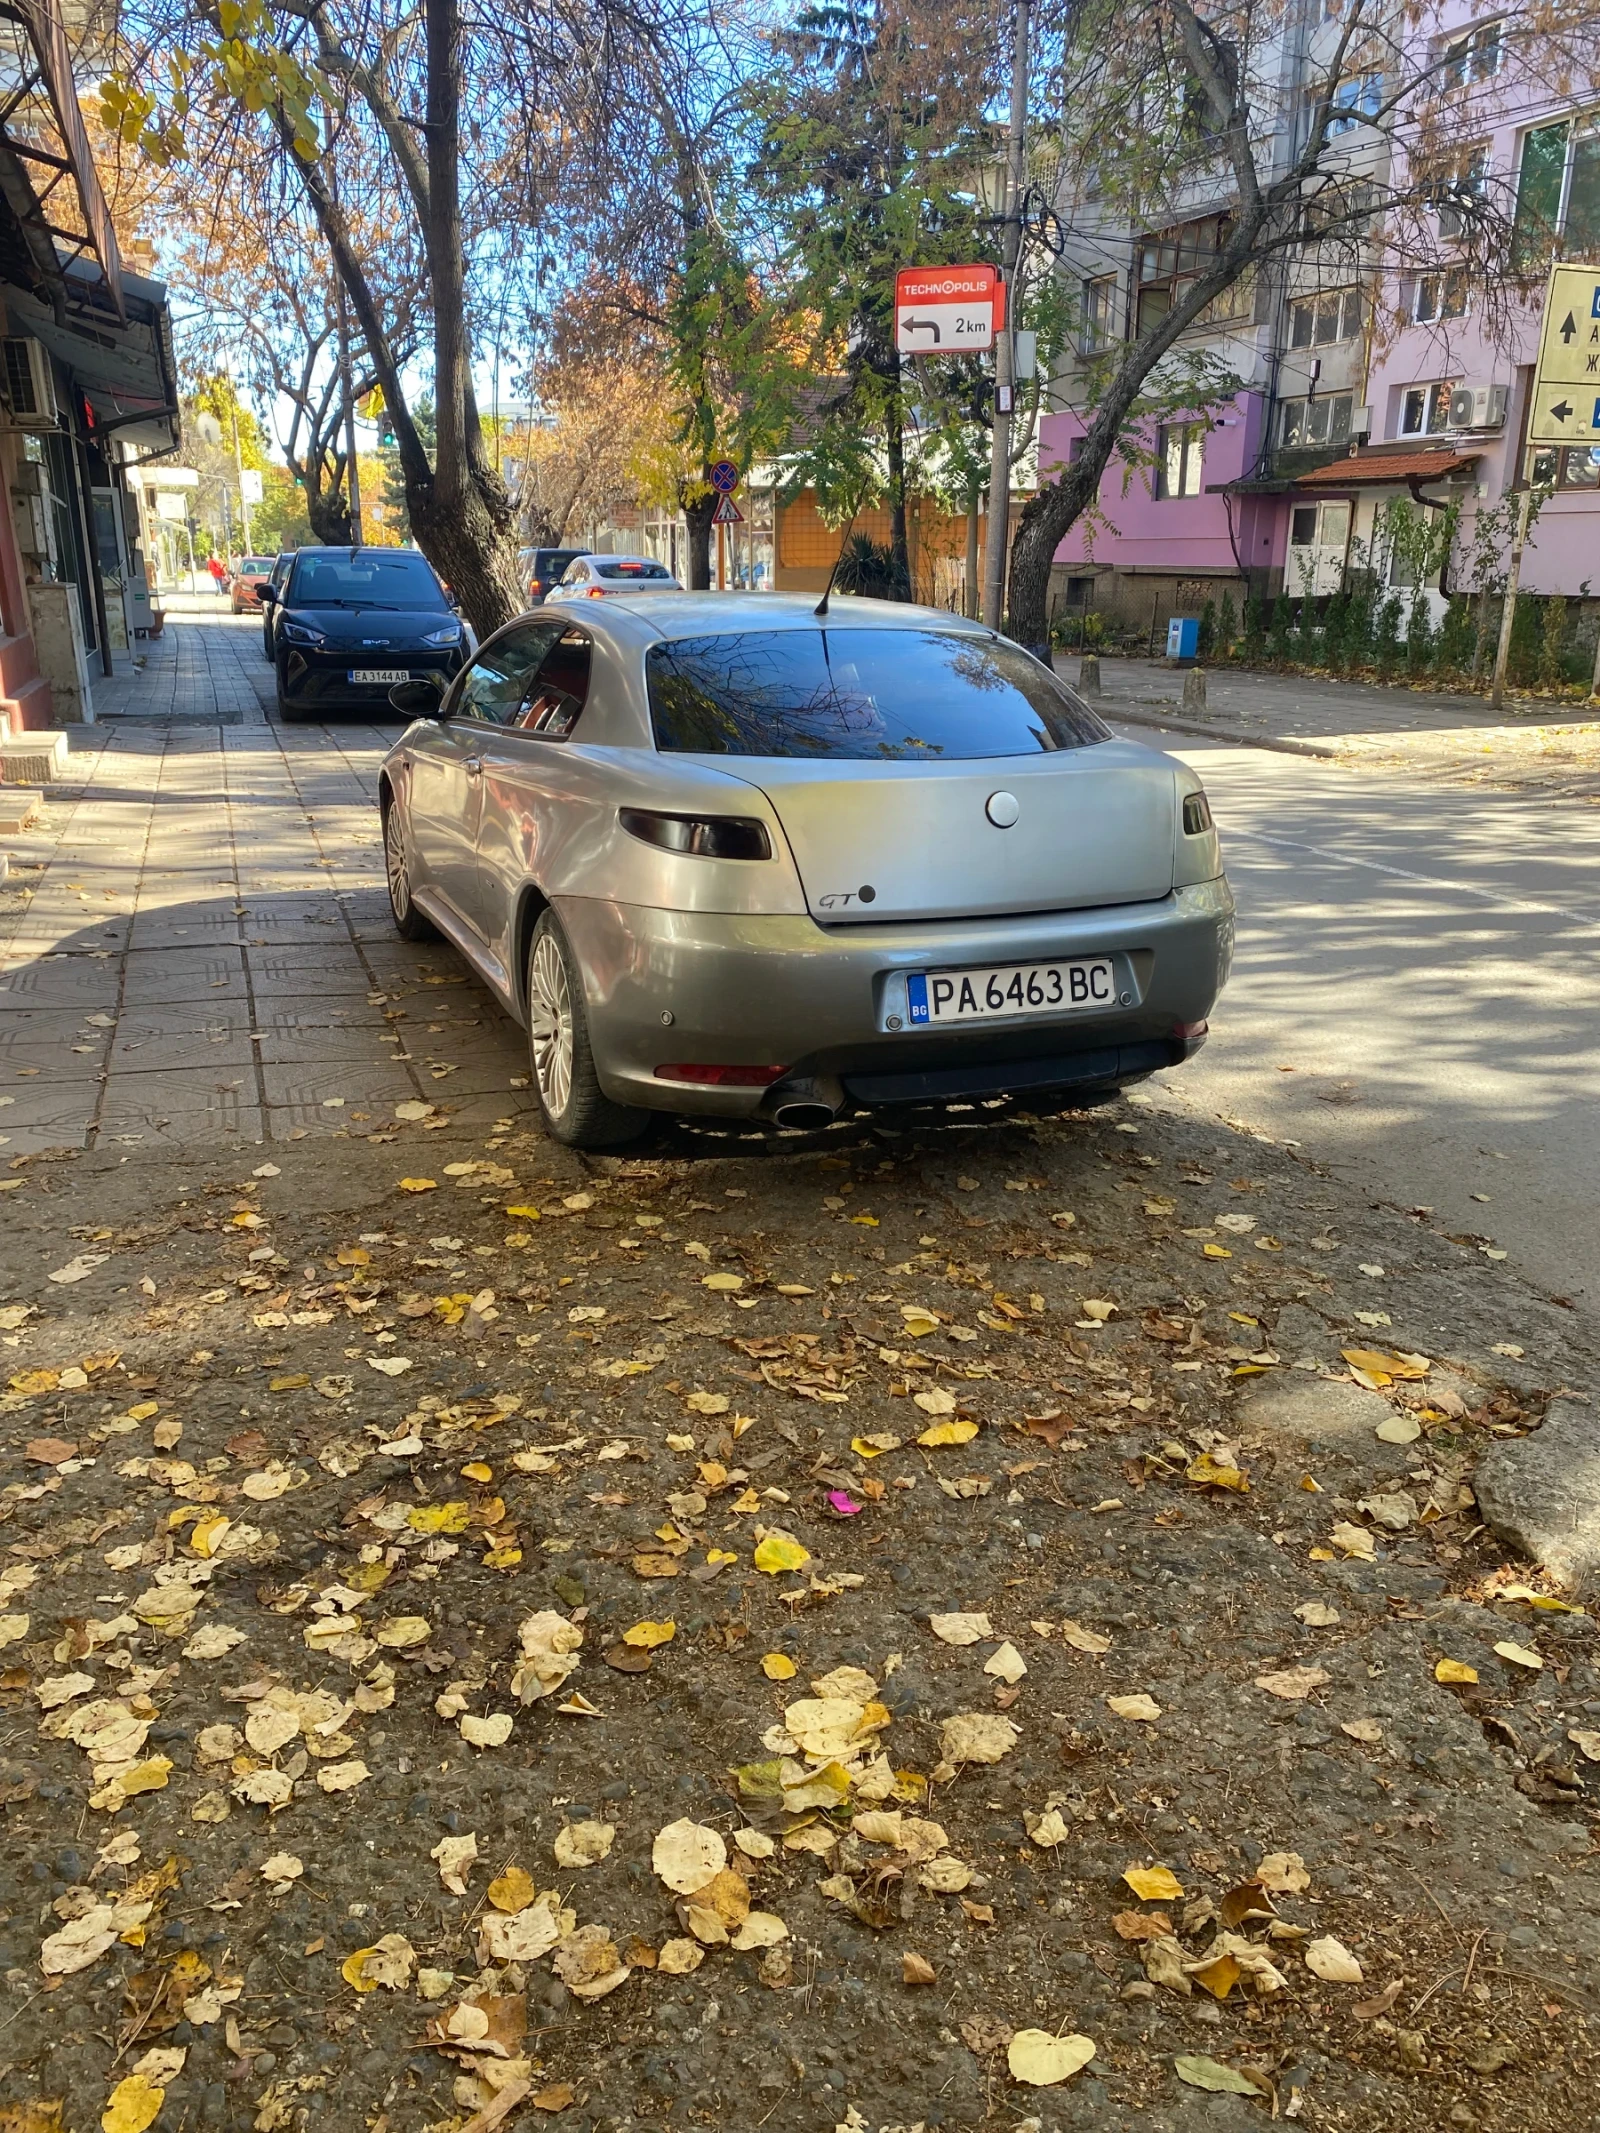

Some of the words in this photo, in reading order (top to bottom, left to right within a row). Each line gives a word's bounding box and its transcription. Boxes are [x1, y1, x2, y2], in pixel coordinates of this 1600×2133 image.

[956, 318, 965, 333] 2
[967, 320, 986, 332] km
[819, 893, 857, 909] GT
[912, 1005, 927, 1016] BG
